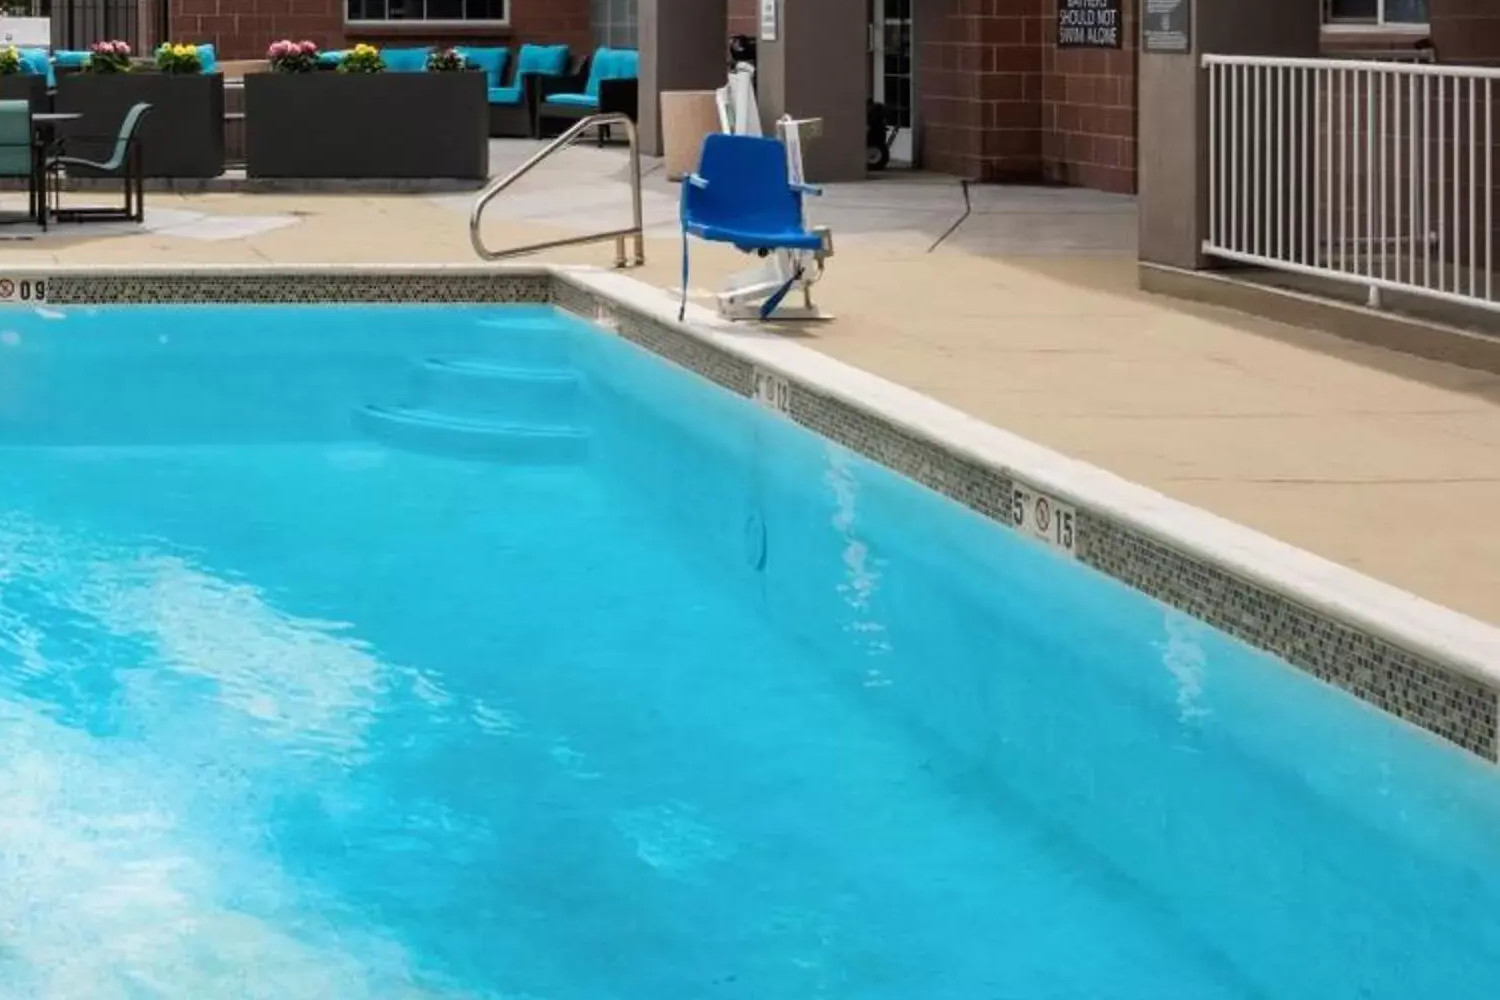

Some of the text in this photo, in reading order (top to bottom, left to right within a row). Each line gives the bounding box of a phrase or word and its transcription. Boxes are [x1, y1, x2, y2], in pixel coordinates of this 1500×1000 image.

[1059, 8, 1117, 26] SHOULD NOT
[1060, 26, 1117, 46] SWIM ALONE
[1013, 490, 1024, 526] 5
